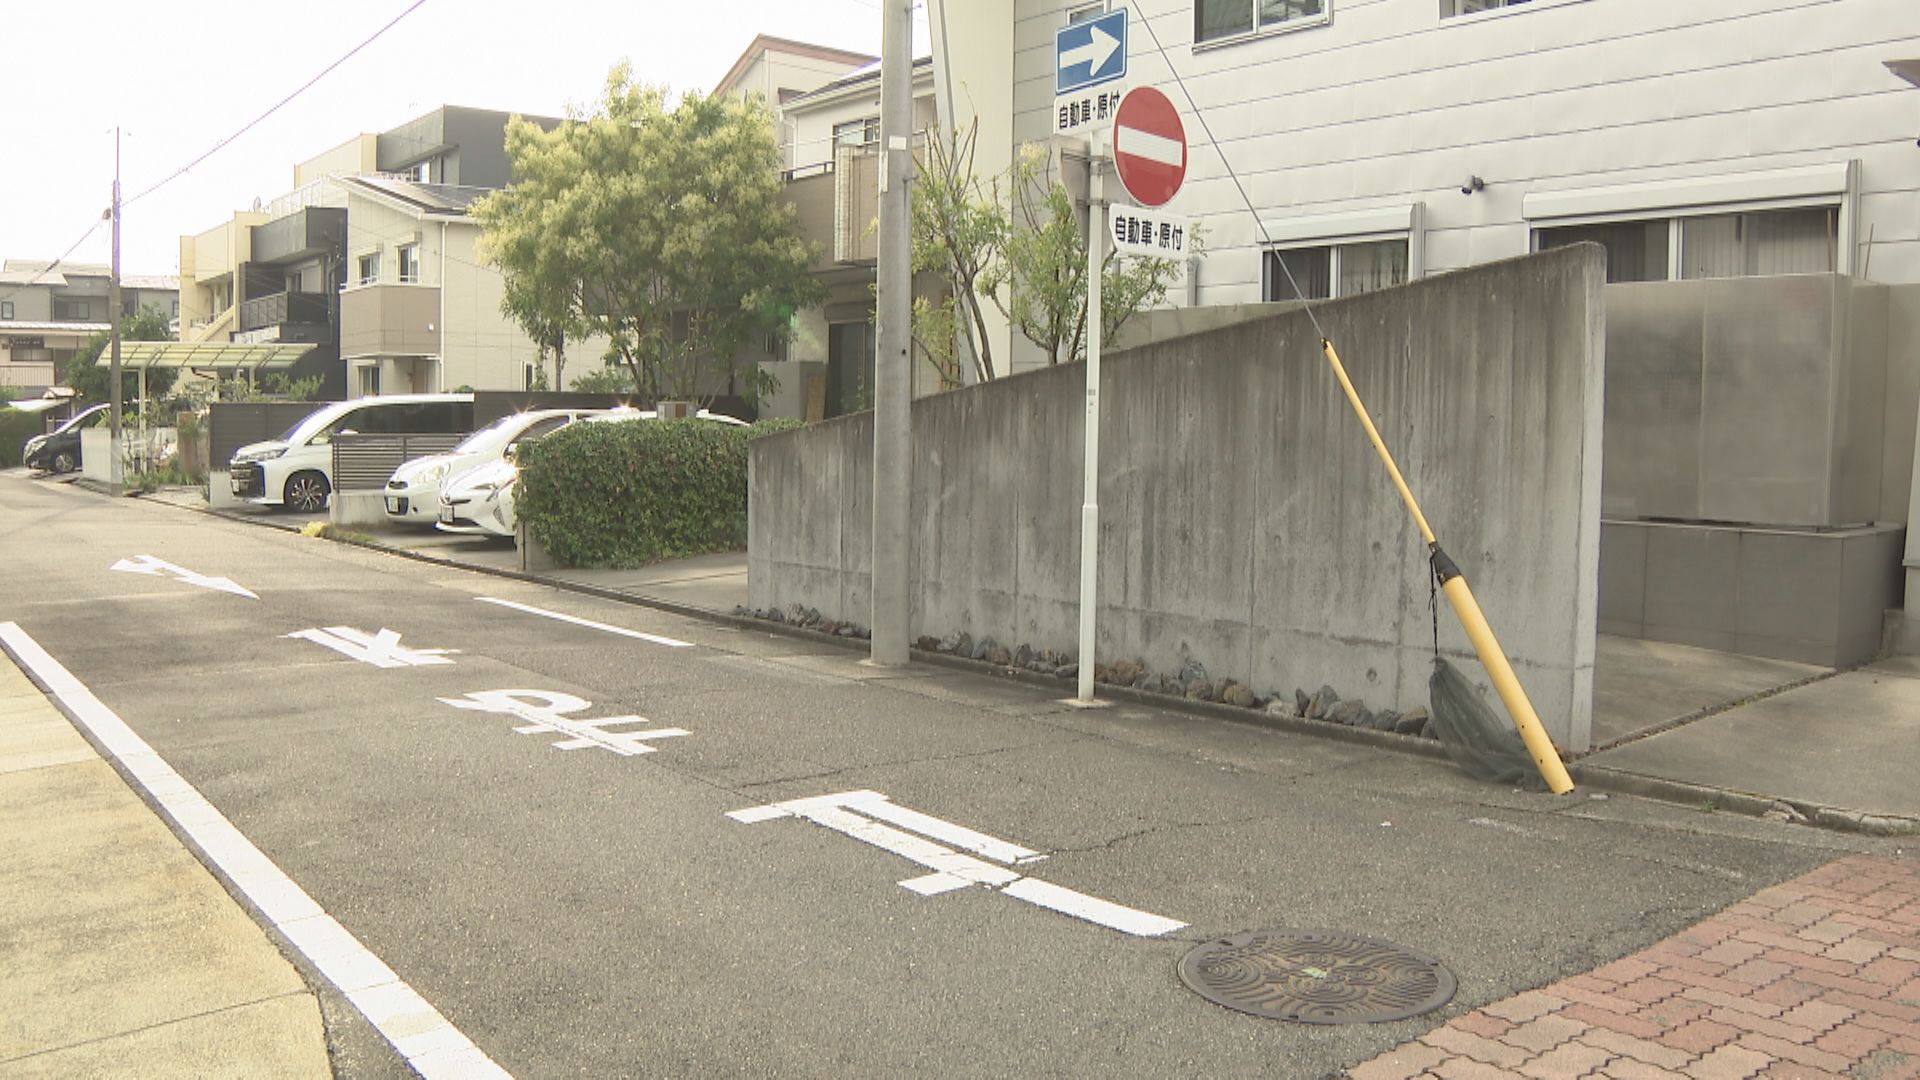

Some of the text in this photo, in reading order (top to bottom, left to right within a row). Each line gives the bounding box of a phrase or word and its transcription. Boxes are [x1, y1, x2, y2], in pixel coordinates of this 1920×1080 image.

[1115, 214, 1183, 250] 自動車・原付
